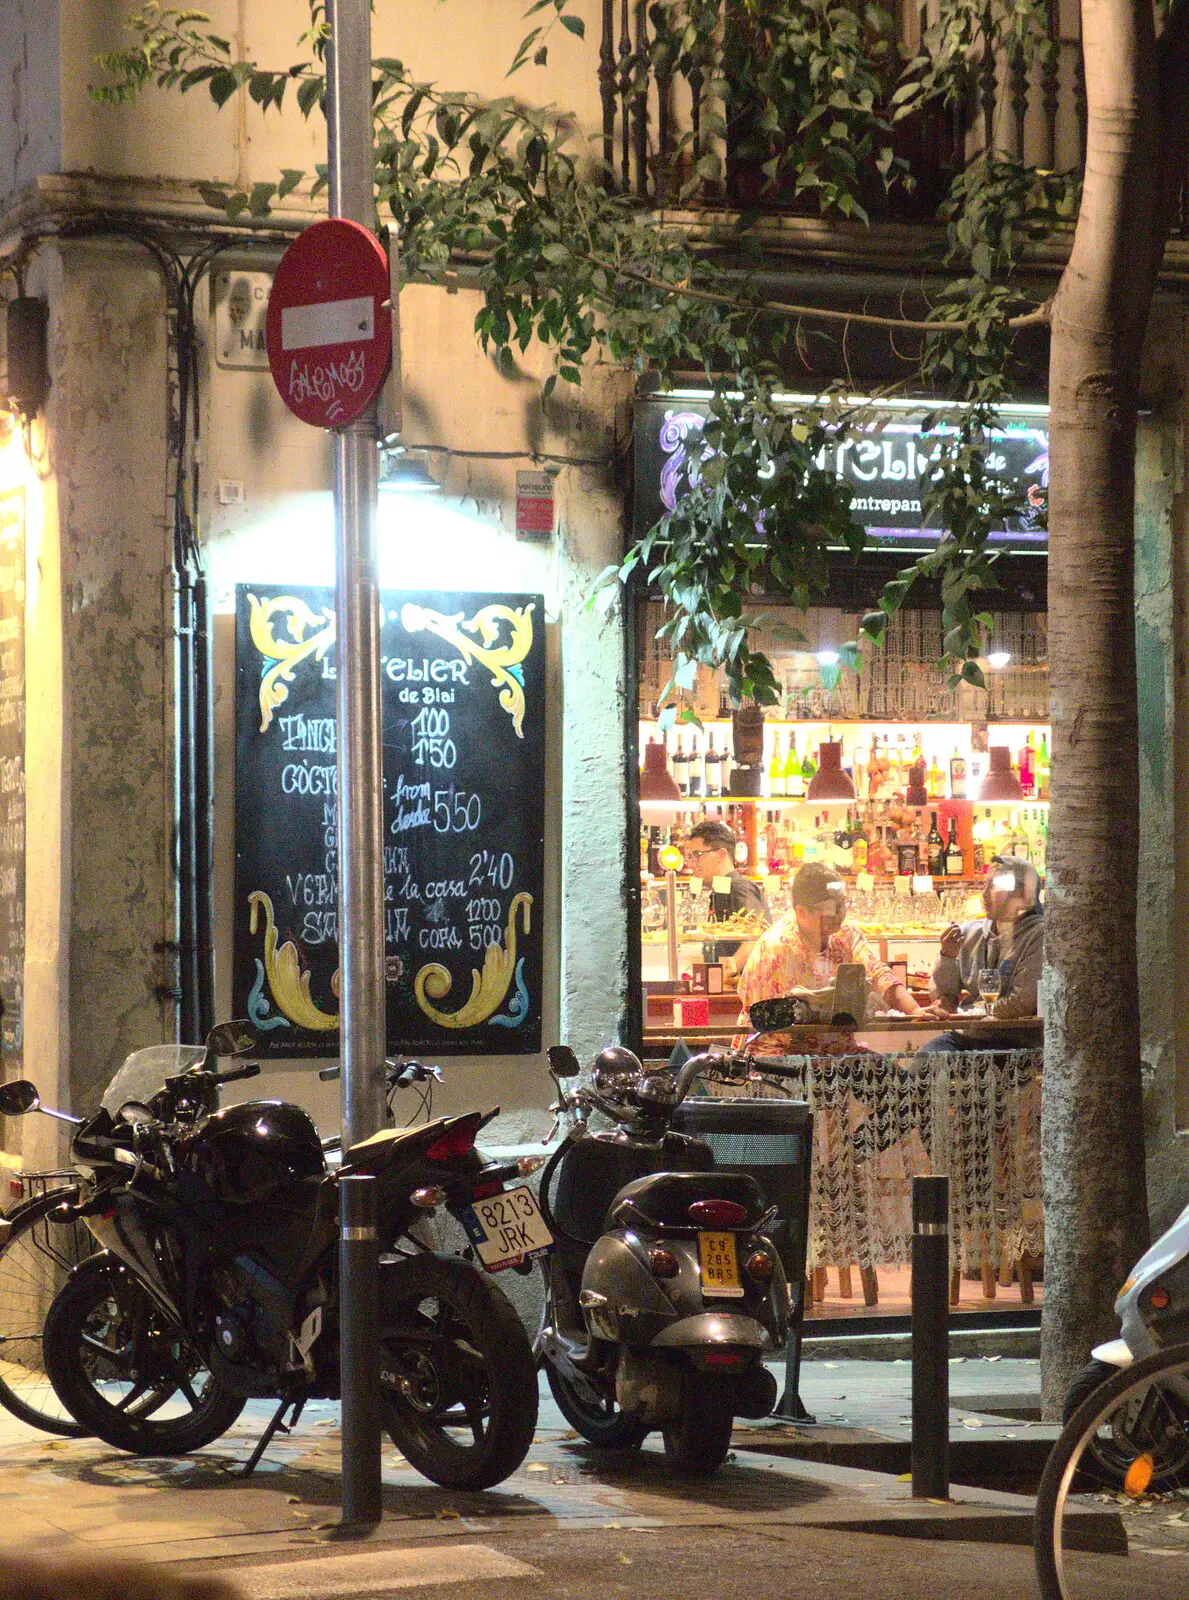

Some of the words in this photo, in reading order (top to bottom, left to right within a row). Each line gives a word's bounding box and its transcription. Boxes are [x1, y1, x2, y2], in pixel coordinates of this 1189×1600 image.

[398, 687, 419, 703] de
[422, 686, 455, 704] Blai
[390, 774, 431, 806] from
[400, 874, 420, 900] la
[425, 879, 469, 899] casa
[418, 927, 463, 949] COPA
[481, 1194, 534, 1228] 8213
[472, 1227, 482, 1237] E
[499, 1221, 536, 1254] JRK
